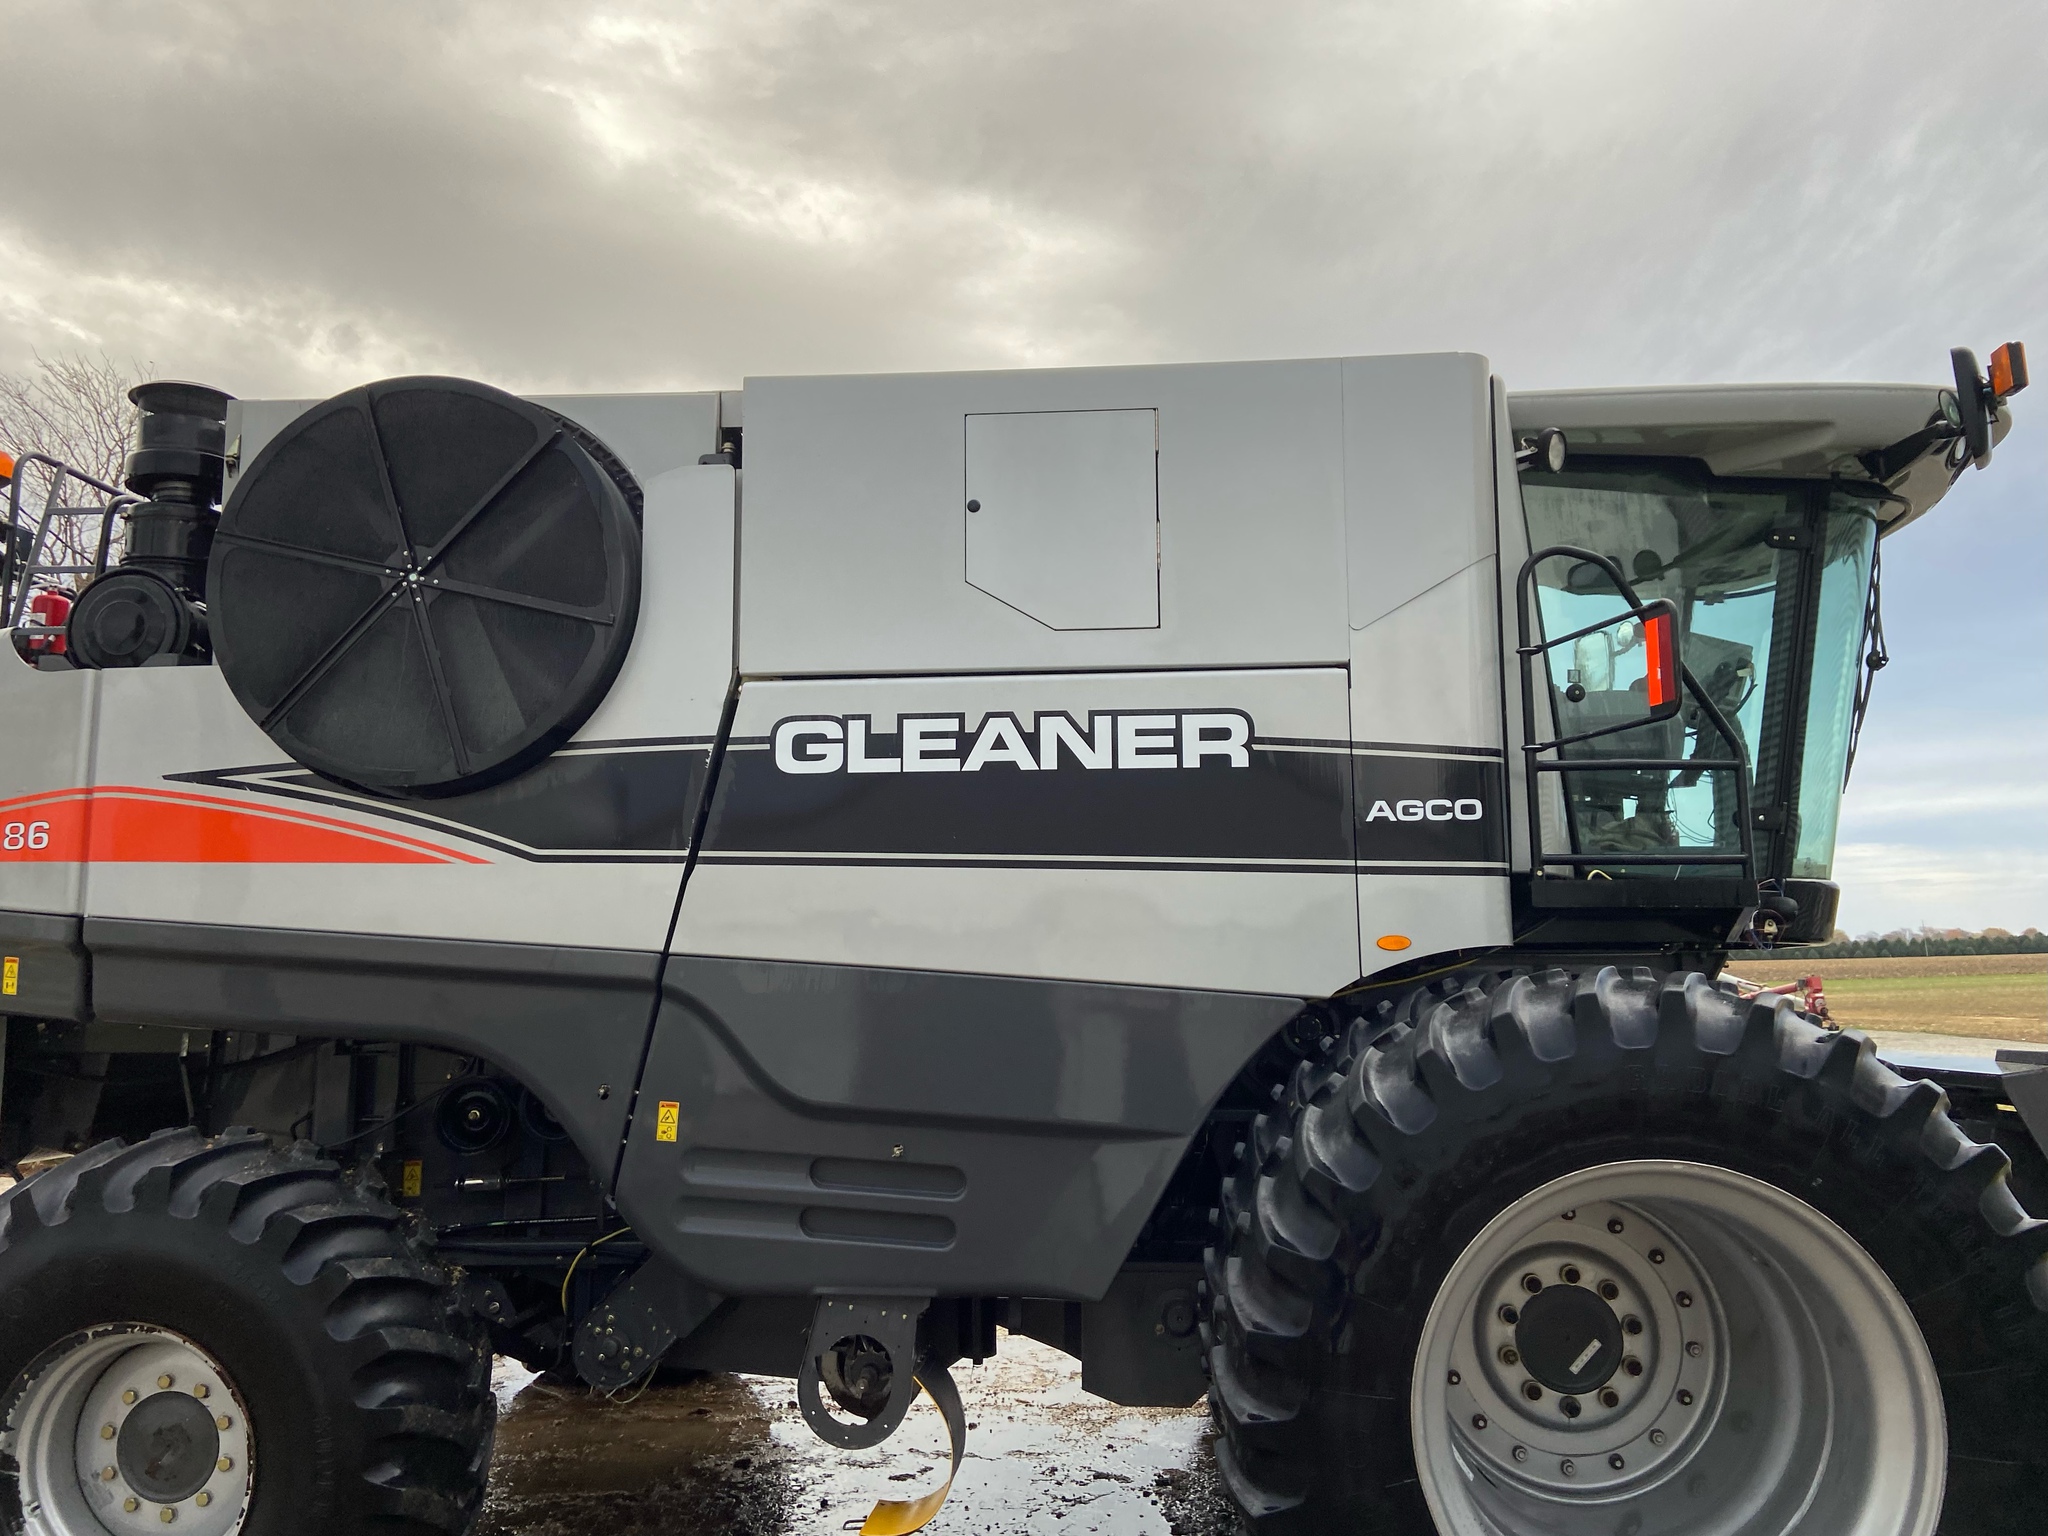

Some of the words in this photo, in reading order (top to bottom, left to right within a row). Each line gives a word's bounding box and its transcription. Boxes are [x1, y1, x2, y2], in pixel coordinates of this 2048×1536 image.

[775, 714, 1250, 774] GLEANER
[1365, 798, 1484, 823] AGCO
[3, 820, 50, 850] 86
